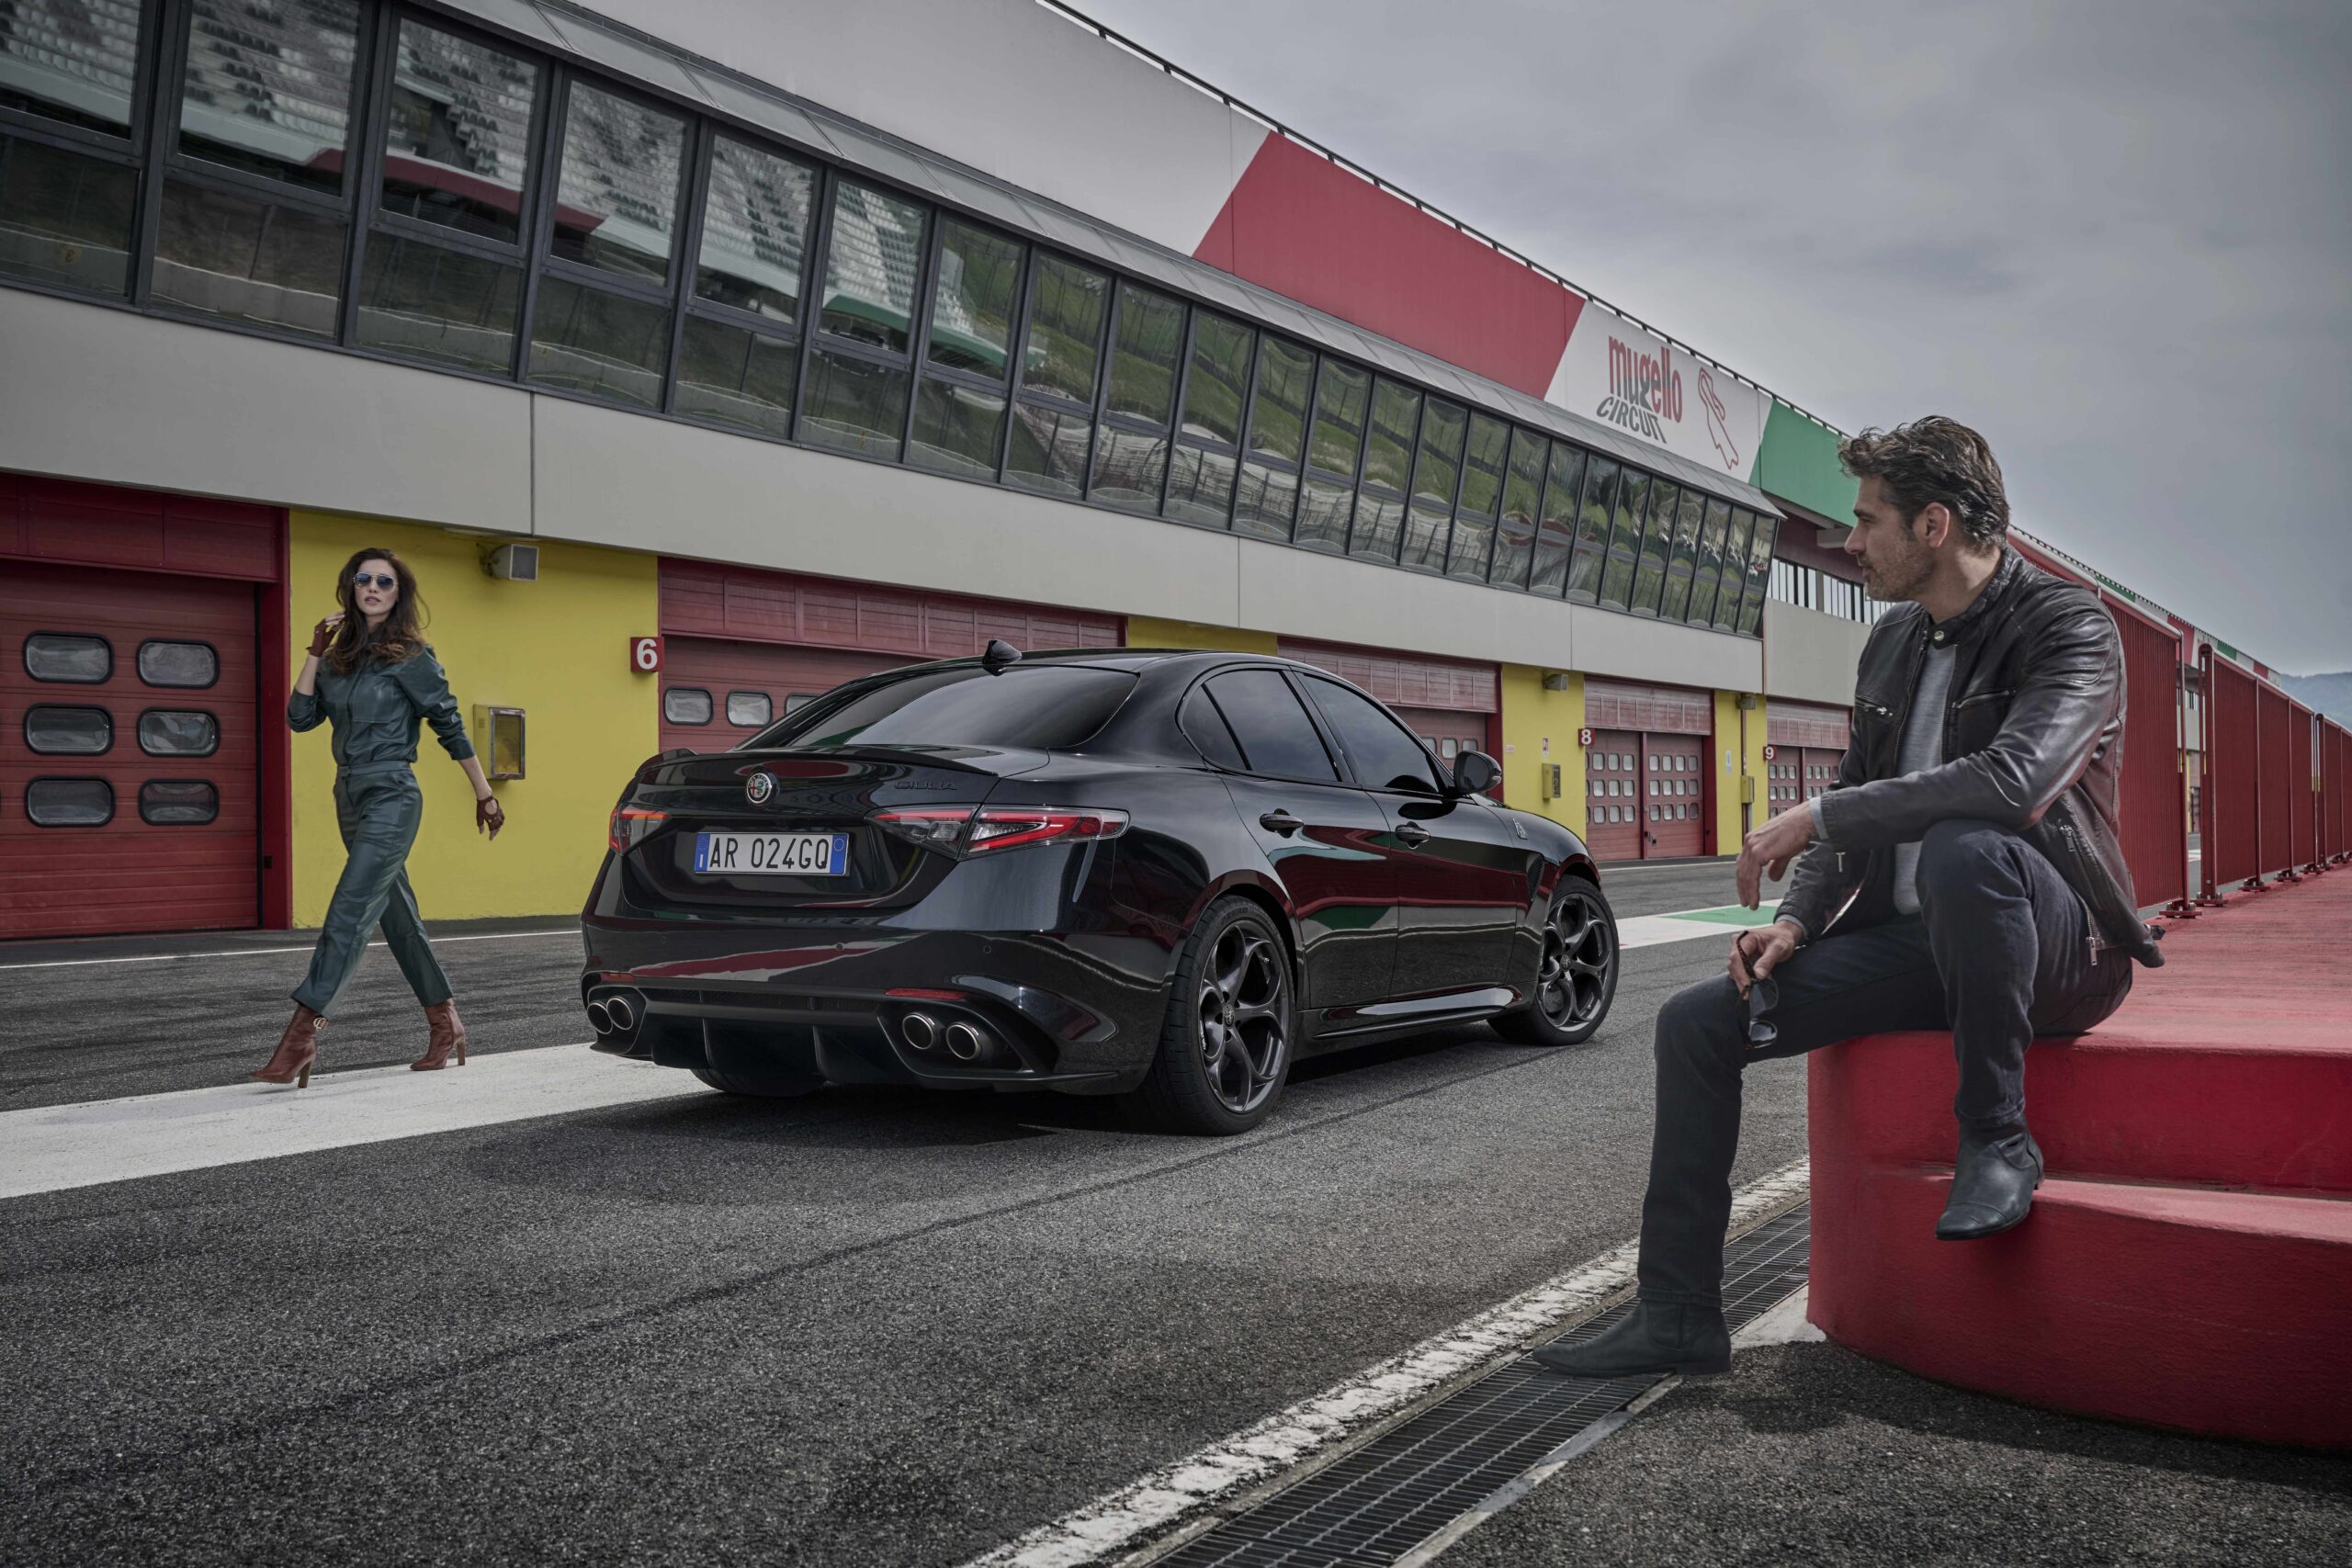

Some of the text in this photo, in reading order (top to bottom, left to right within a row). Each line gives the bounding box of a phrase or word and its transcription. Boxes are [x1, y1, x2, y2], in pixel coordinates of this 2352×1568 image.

[1608, 334, 1683, 423] mugello
[1596, 396, 1668, 445] CIRCUIT
[637, 637, 658, 670] 6
[1581, 728, 1592, 745] 8
[1765, 746, 1775, 760] 9
[709, 837, 830, 870] AR 024GQ
